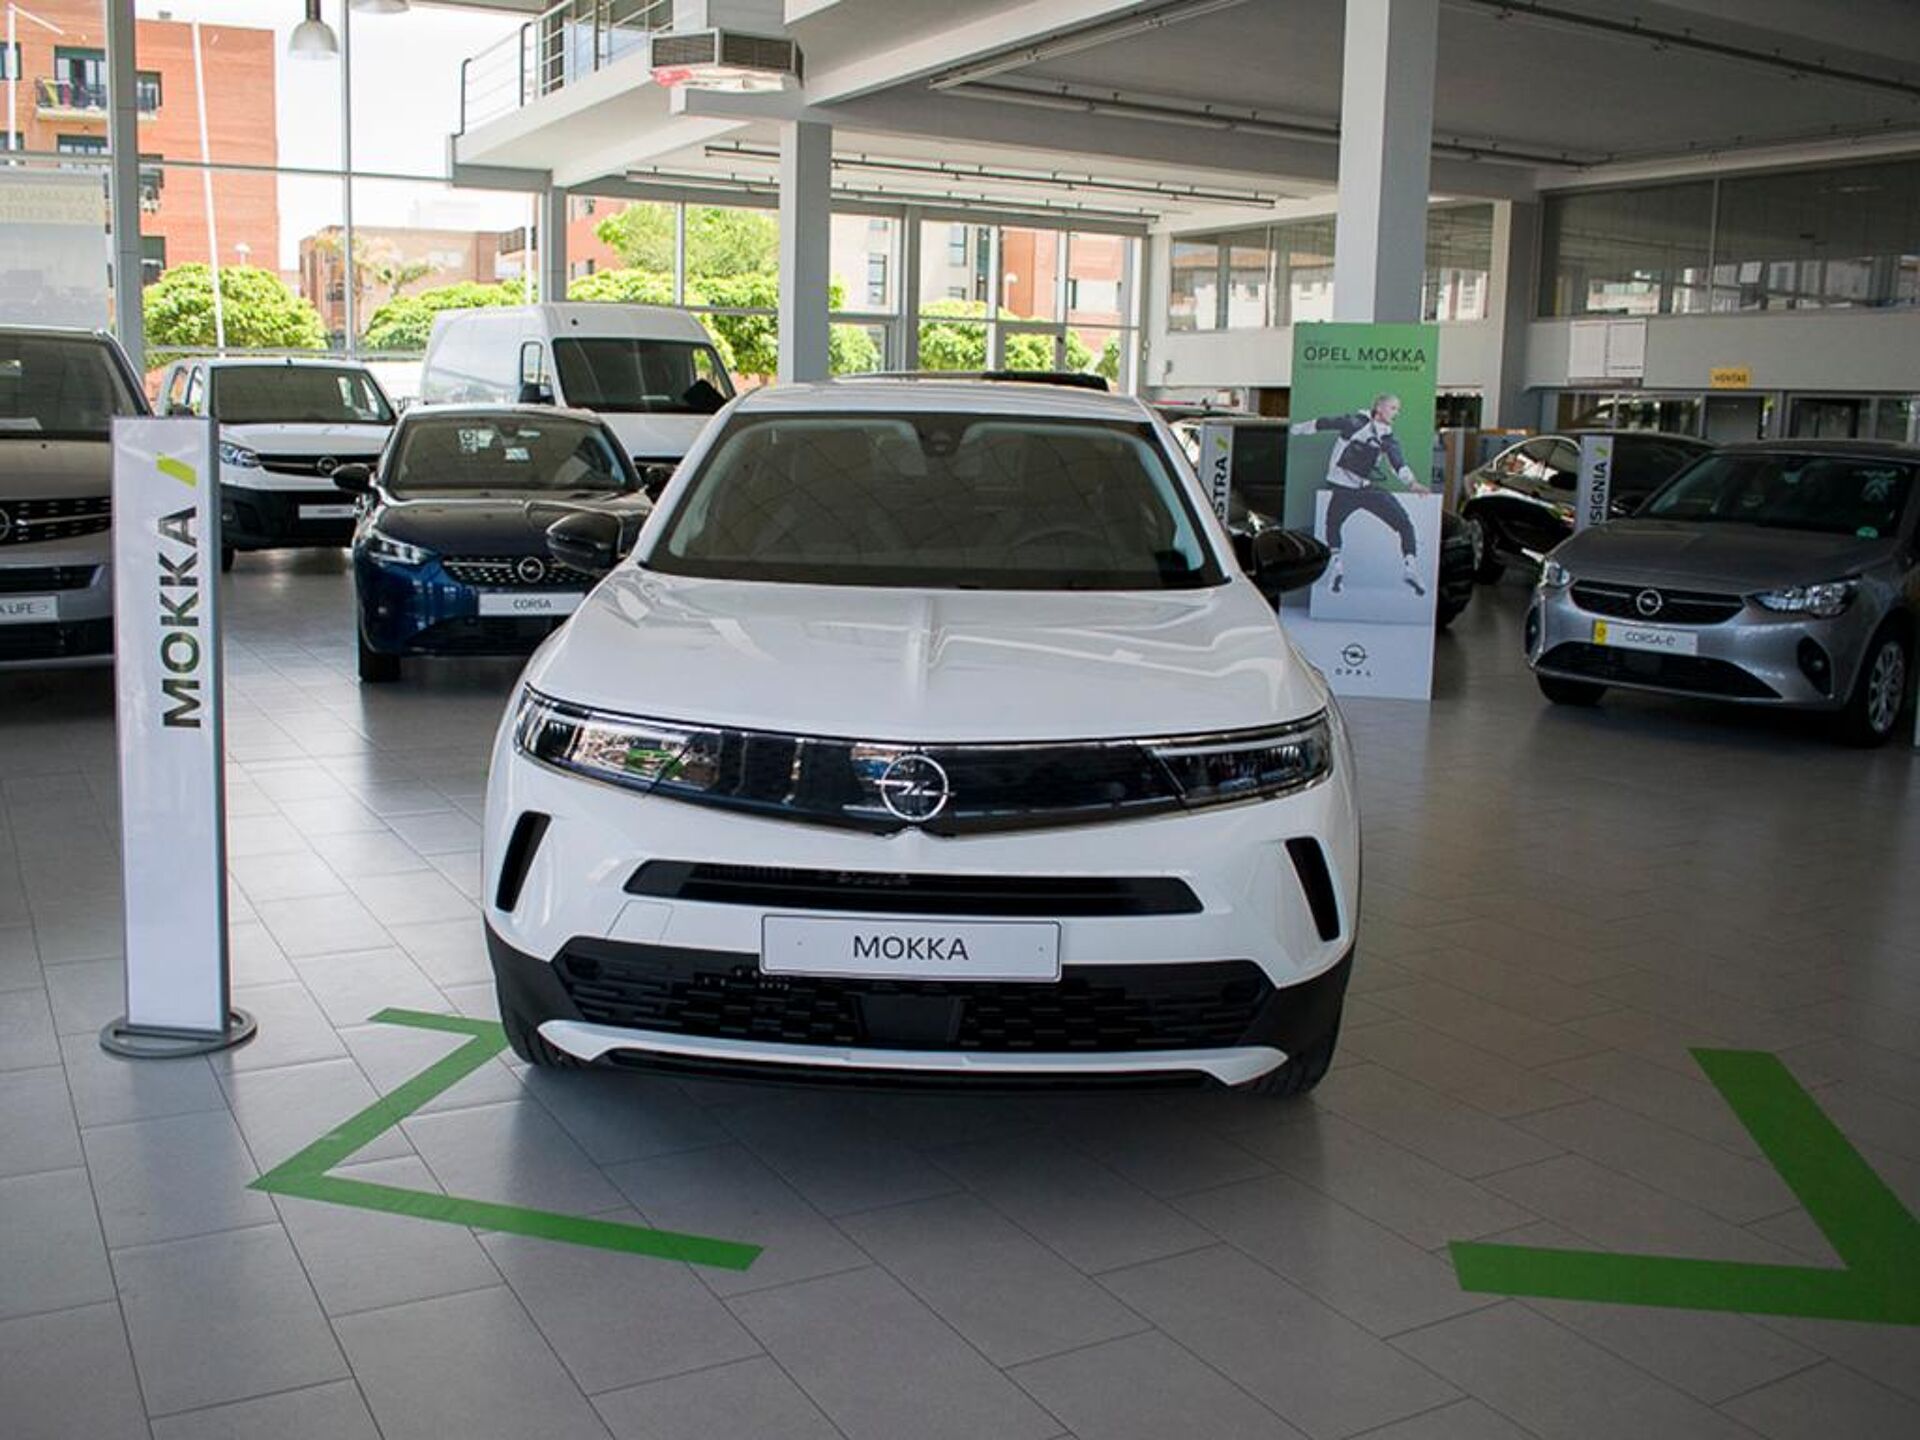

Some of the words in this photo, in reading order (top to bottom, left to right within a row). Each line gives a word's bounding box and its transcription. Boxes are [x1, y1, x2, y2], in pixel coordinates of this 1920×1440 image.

[1304, 346, 1351, 361] OPEL
[1357, 347, 1426, 363] MOKKA
[1212, 456, 1228, 520] STRA
[158, 506, 201, 728] MOKKA
[513, 599, 552, 610] CORSA
[853, 935, 969, 961] MOKKA
